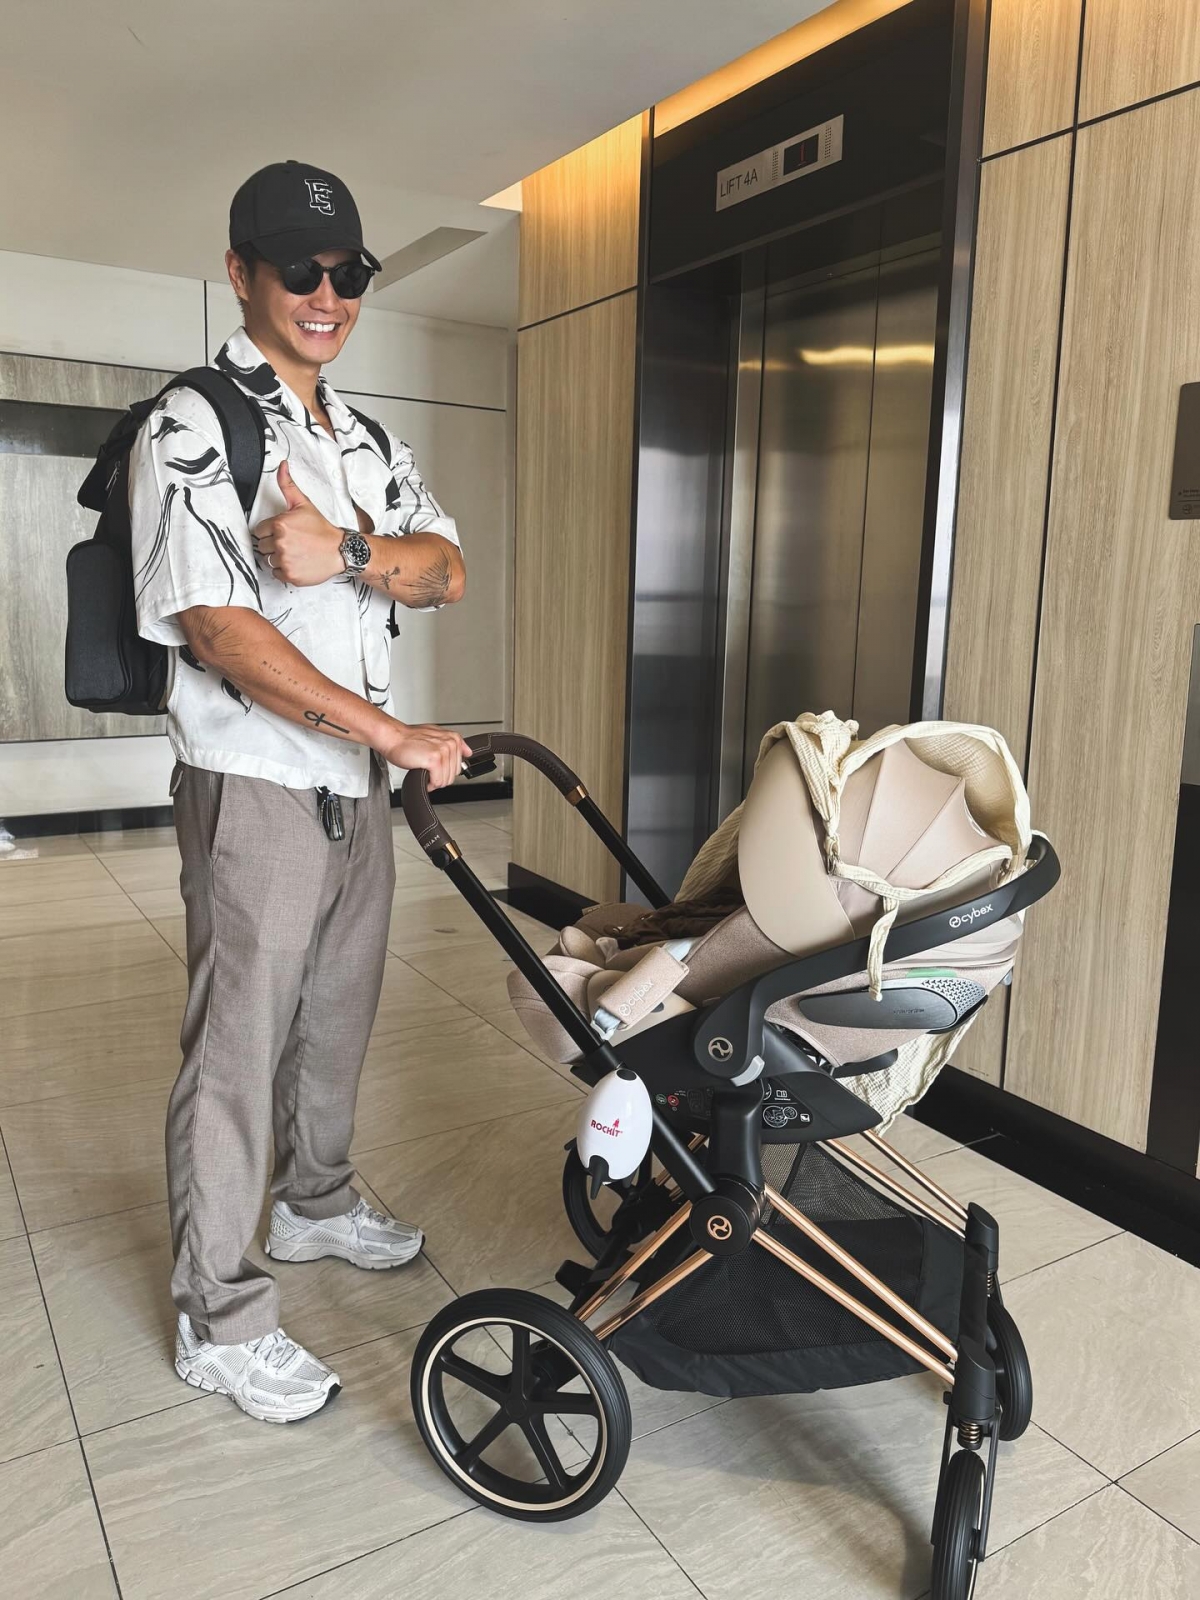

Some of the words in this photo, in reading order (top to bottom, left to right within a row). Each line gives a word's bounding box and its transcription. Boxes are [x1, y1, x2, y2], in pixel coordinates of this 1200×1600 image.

[720, 174, 742, 197] LIFT
[743, 168, 758, 185] 4A
[961, 903, 994, 925] cybex
[628, 980, 655, 1006] cybex
